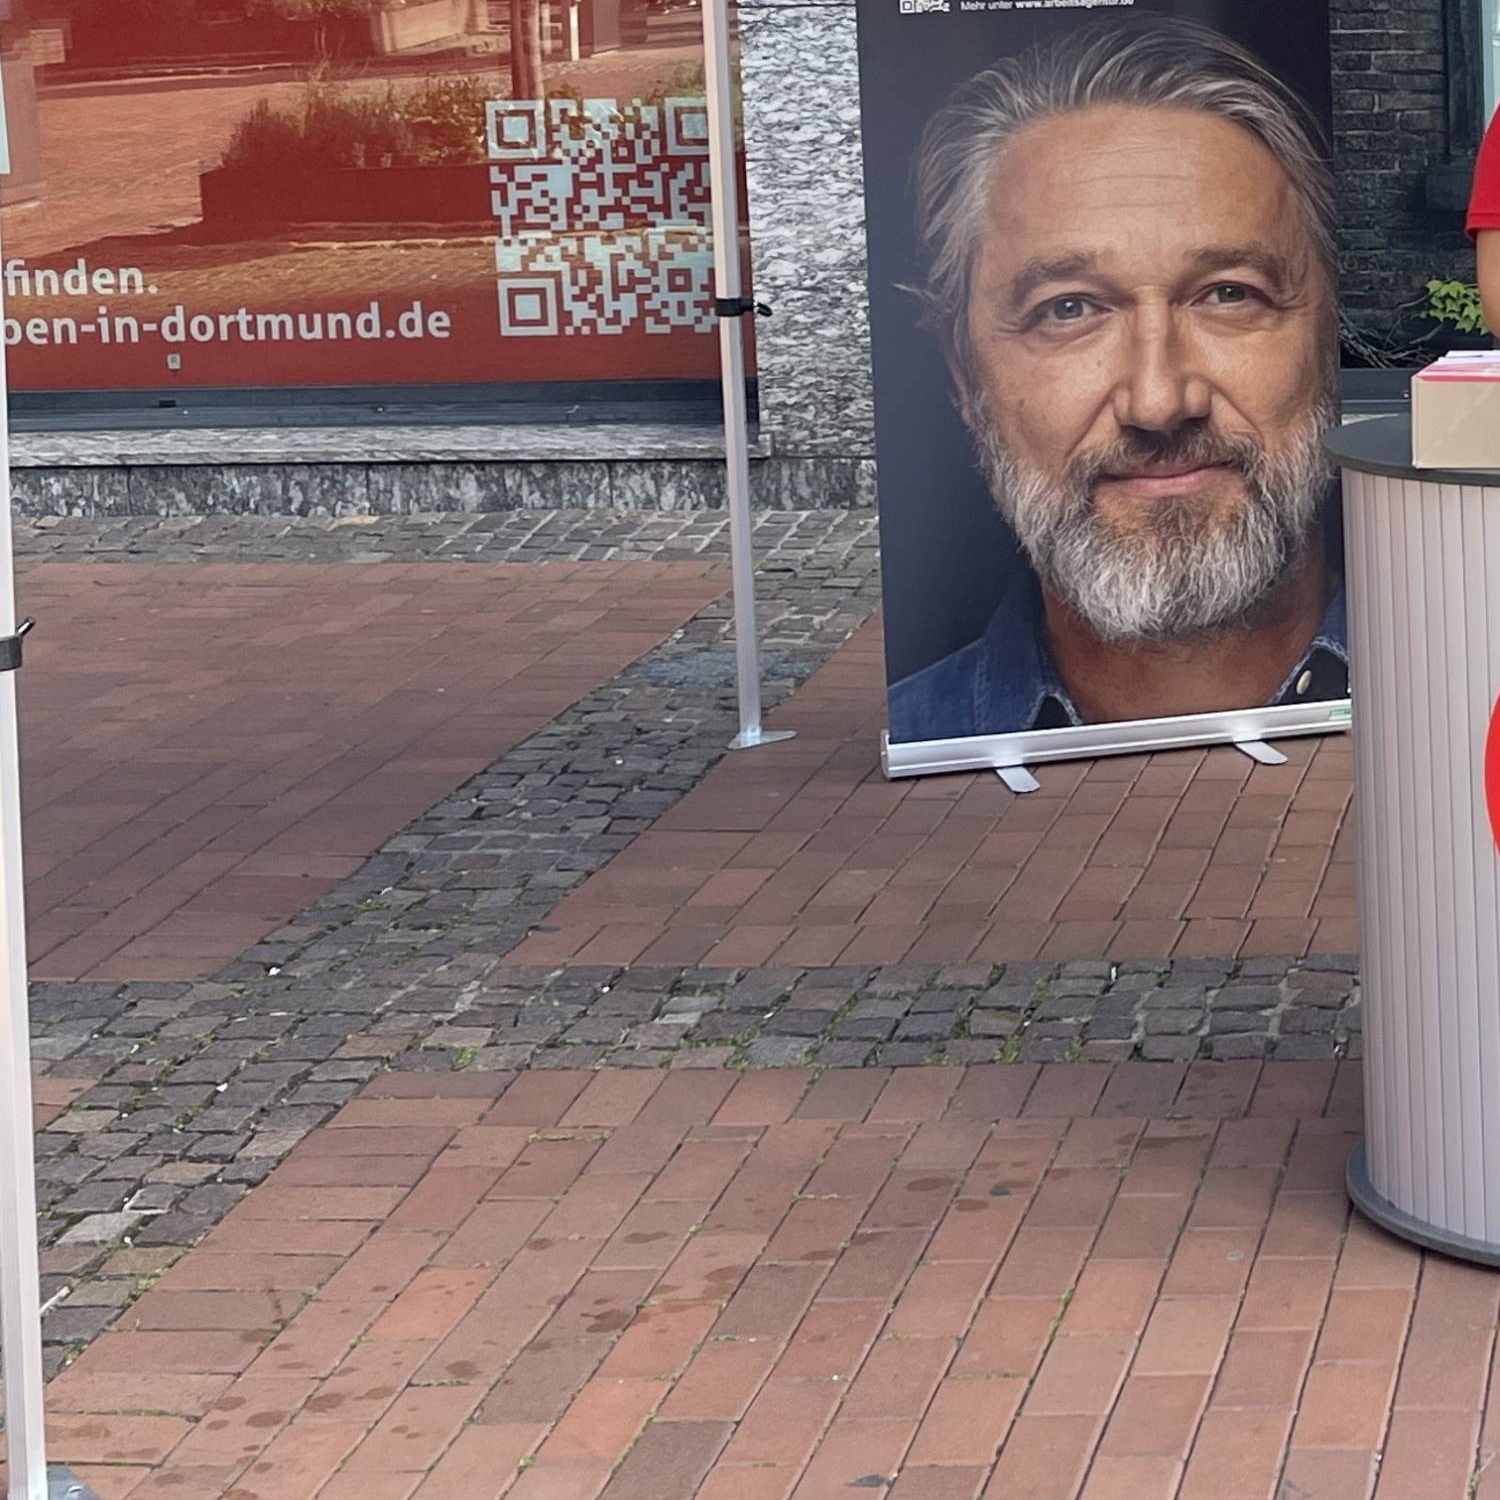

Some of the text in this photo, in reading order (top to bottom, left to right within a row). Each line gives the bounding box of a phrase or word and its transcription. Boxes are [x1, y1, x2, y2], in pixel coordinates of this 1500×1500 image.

[960, 1, 986, 10] Mehr
[987, 0, 1013, 10] unter
[4, 258, 158, 296] finden.
